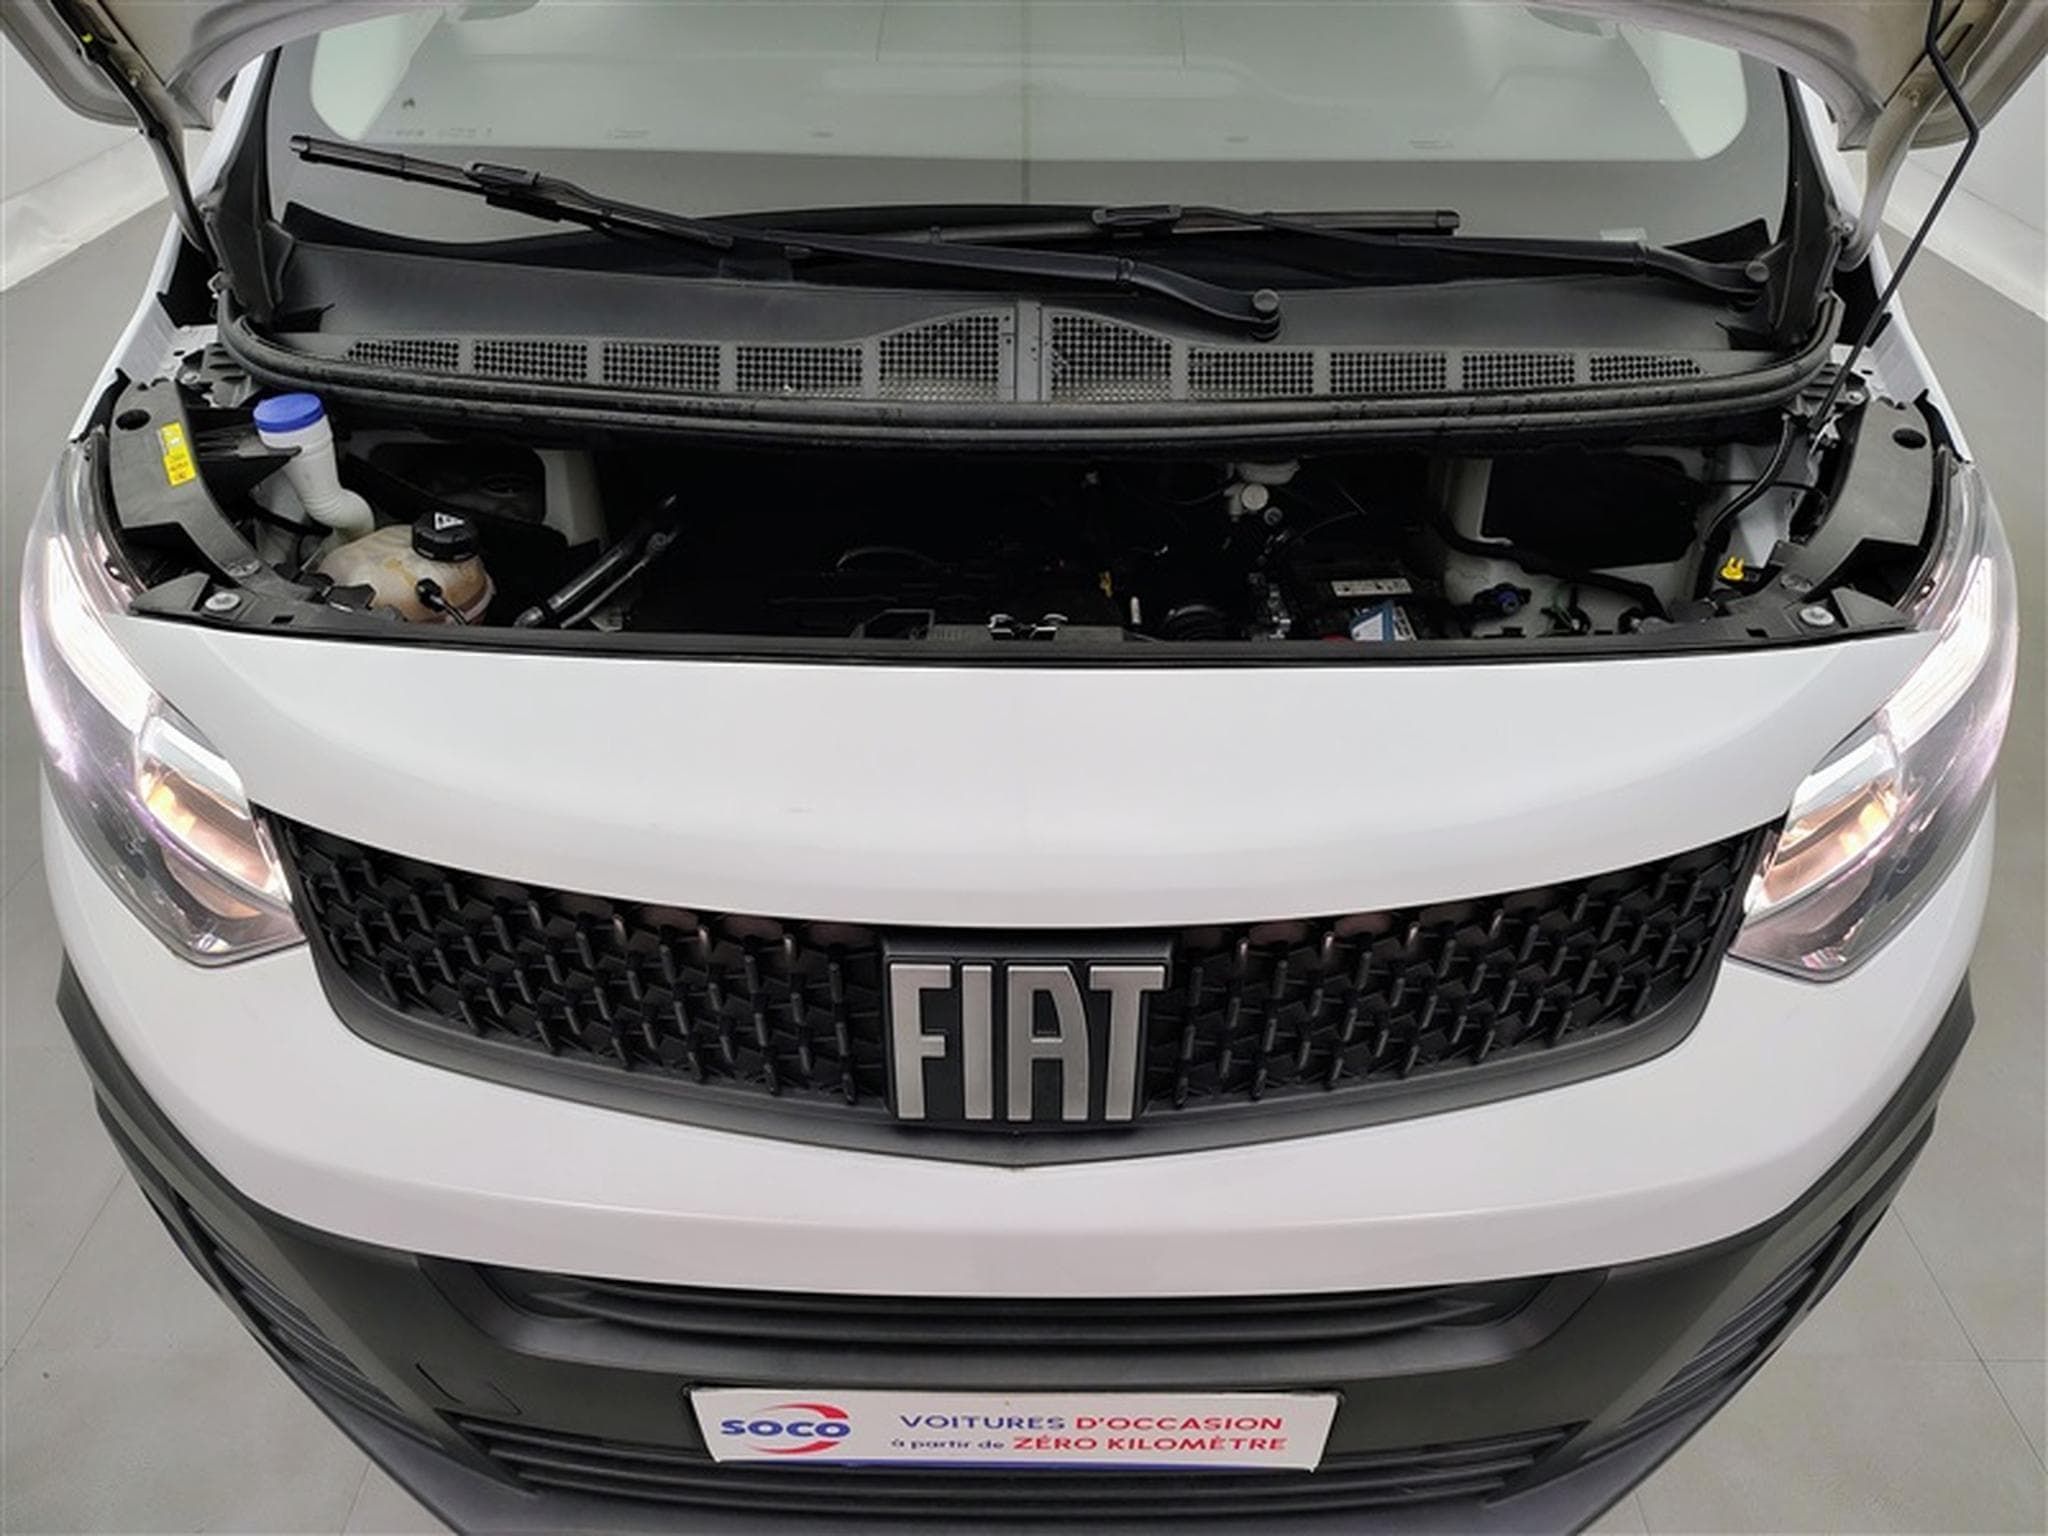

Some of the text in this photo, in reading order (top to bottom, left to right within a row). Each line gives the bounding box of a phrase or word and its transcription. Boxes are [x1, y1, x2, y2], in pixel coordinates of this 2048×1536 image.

[890, 964, 1165, 1121] FIAT
[720, 1419, 850, 1438] SOCO
[900, 1415, 1283, 1431] VOITURES D'OCCASION
[911, 1439, 969, 1449] partir
[978, 1439, 1004, 1449] de
[1013, 1435, 1097, 1450] ZÉRO
[1107, 1436, 1287, 1450] KILOMÈTRE
